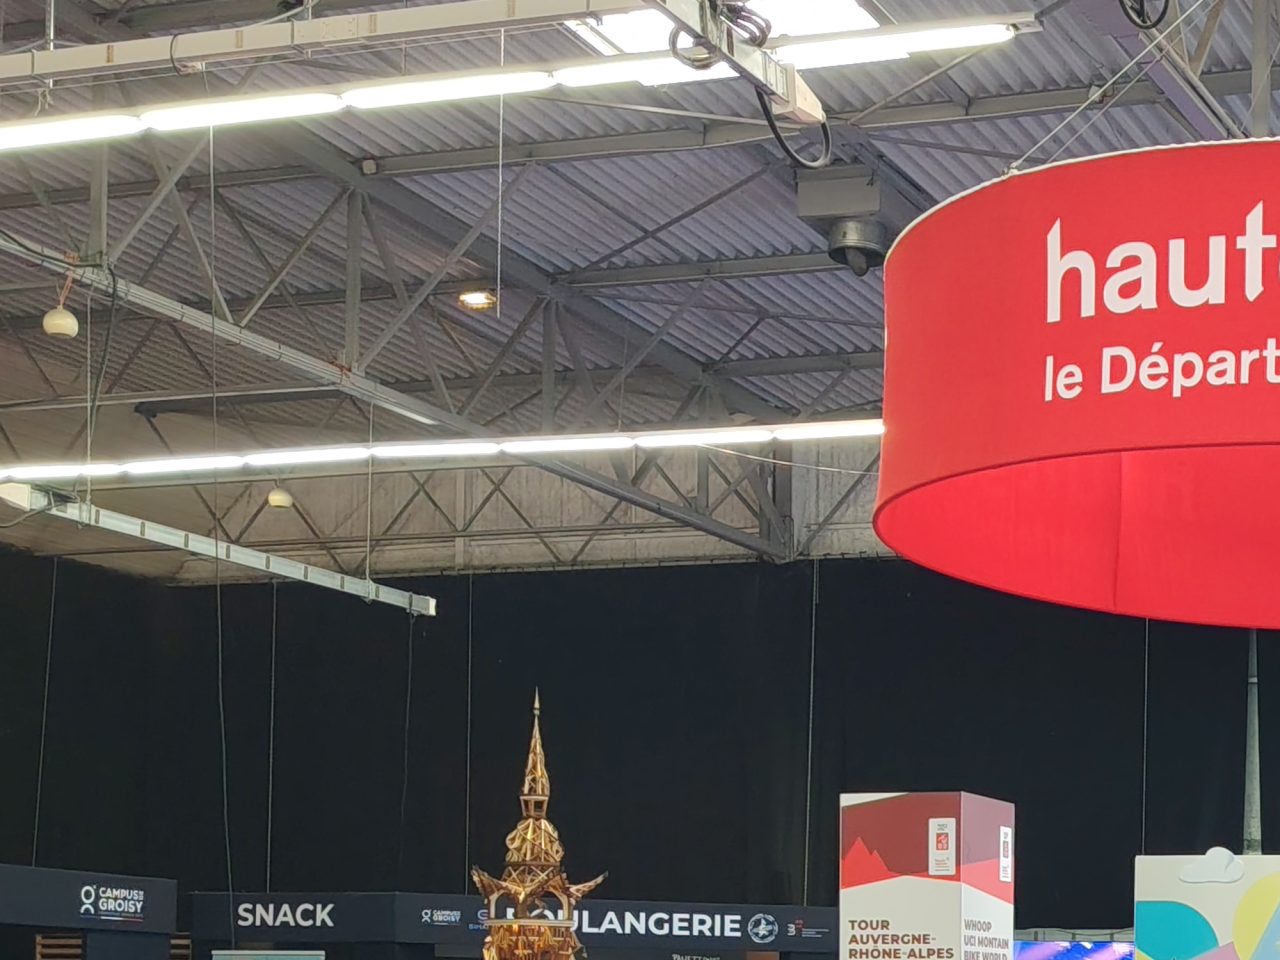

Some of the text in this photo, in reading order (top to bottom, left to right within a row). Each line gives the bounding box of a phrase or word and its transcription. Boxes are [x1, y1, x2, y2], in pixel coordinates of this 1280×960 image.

[1043, 355, 1083, 401] le
[99, 887, 139, 900] CAMPUS
[98, 899, 143, 913] GROISY
[237, 903, 335, 927] SNACK
[848, 919, 890, 931] TOUR
[963, 919, 992, 933] WHOOP
[848, 934, 937, 945] AUVERGNE-
[963, 935, 976, 947] UCI
[848, 946, 954, 960] RHÔNE-ALPES
